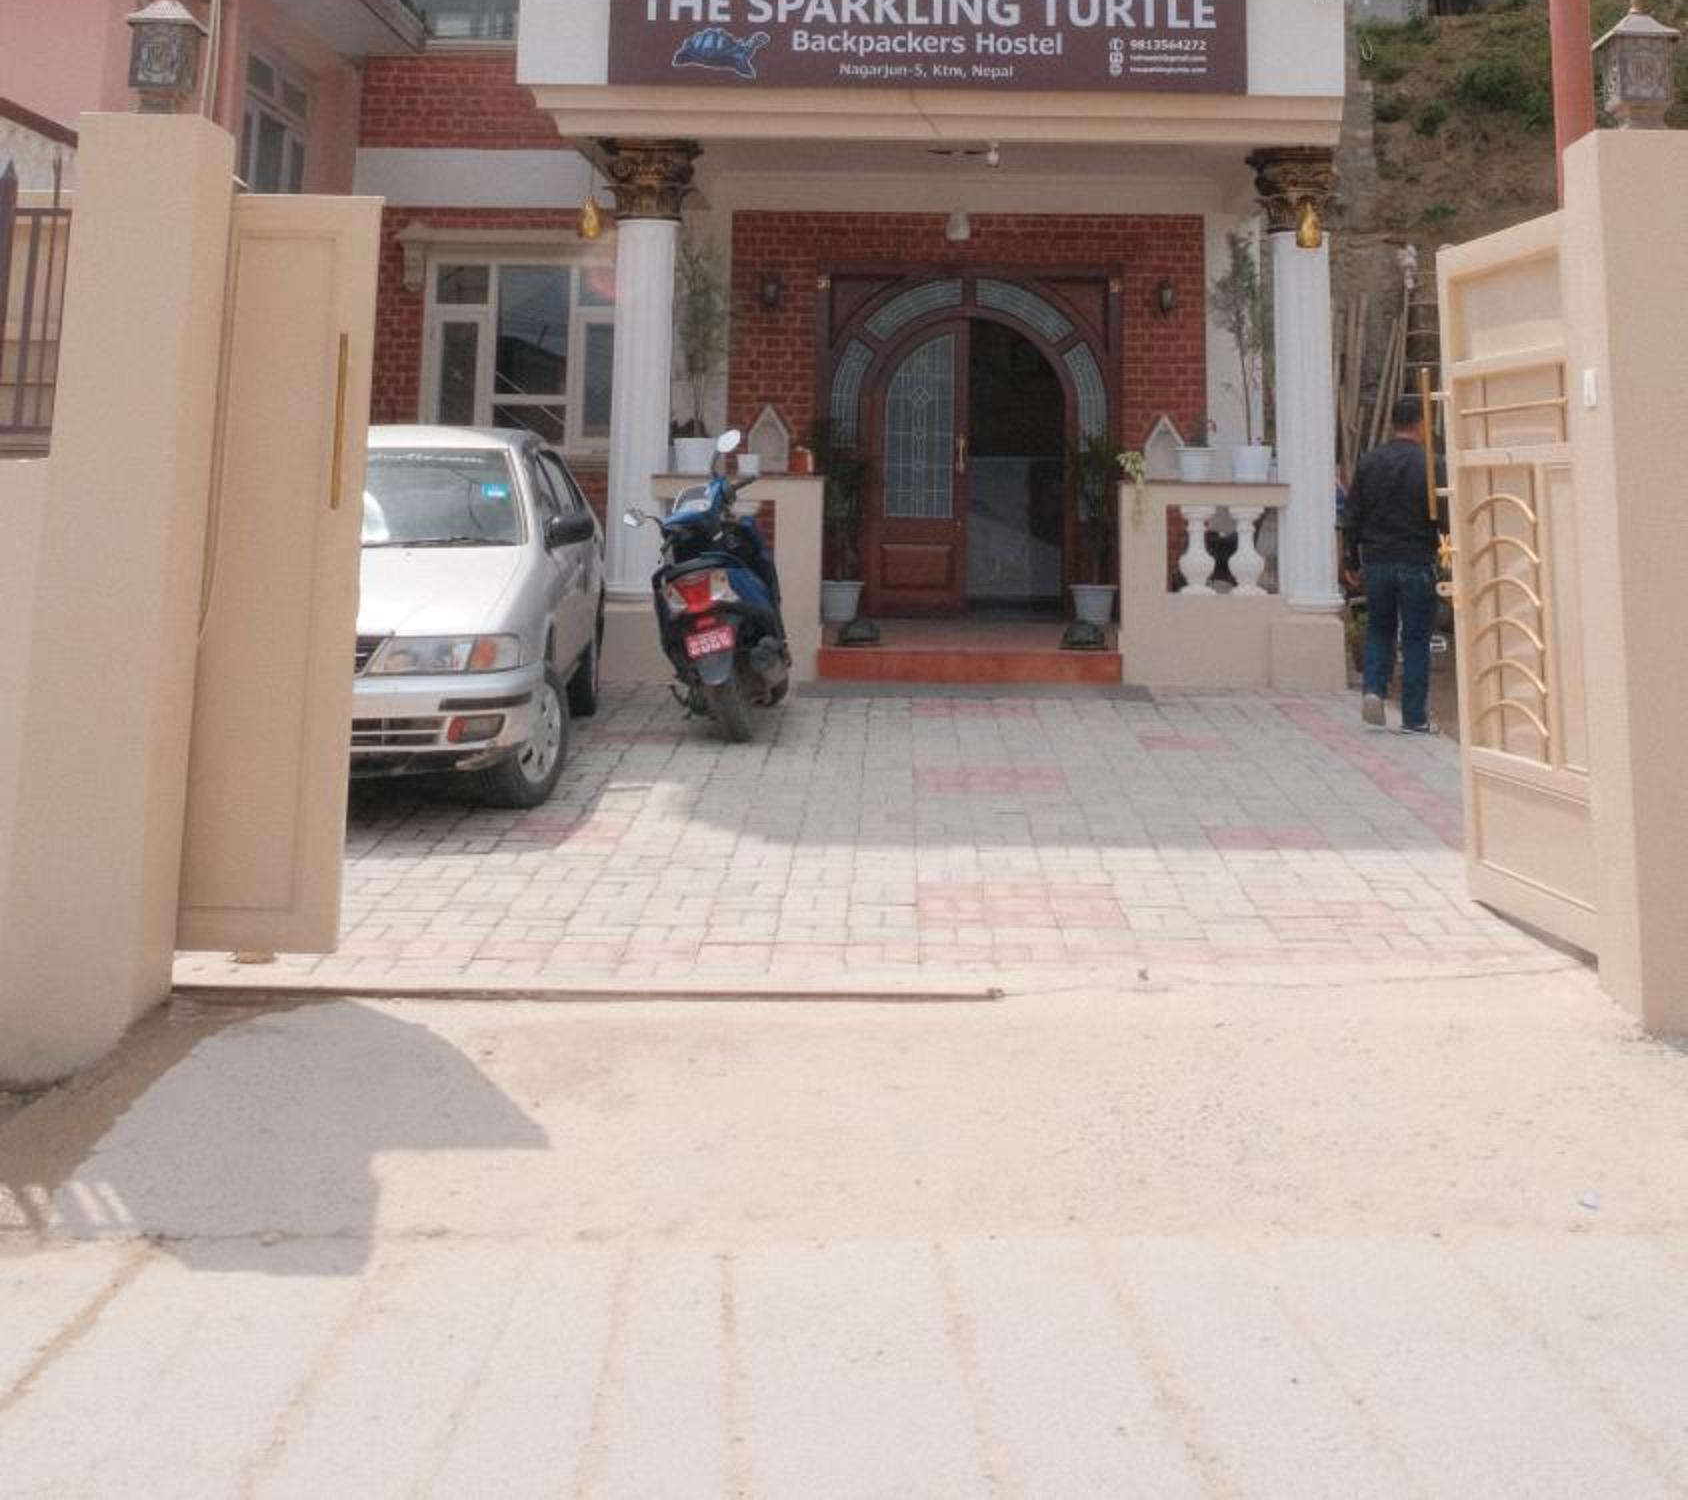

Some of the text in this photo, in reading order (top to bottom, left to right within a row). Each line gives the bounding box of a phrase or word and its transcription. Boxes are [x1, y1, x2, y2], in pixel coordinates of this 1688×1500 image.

[792, 30, 1064, 56] Backpackers Hostel
[933, 64, 966, 78] Ktm,
[972, 64, 1014, 78] Nepal
